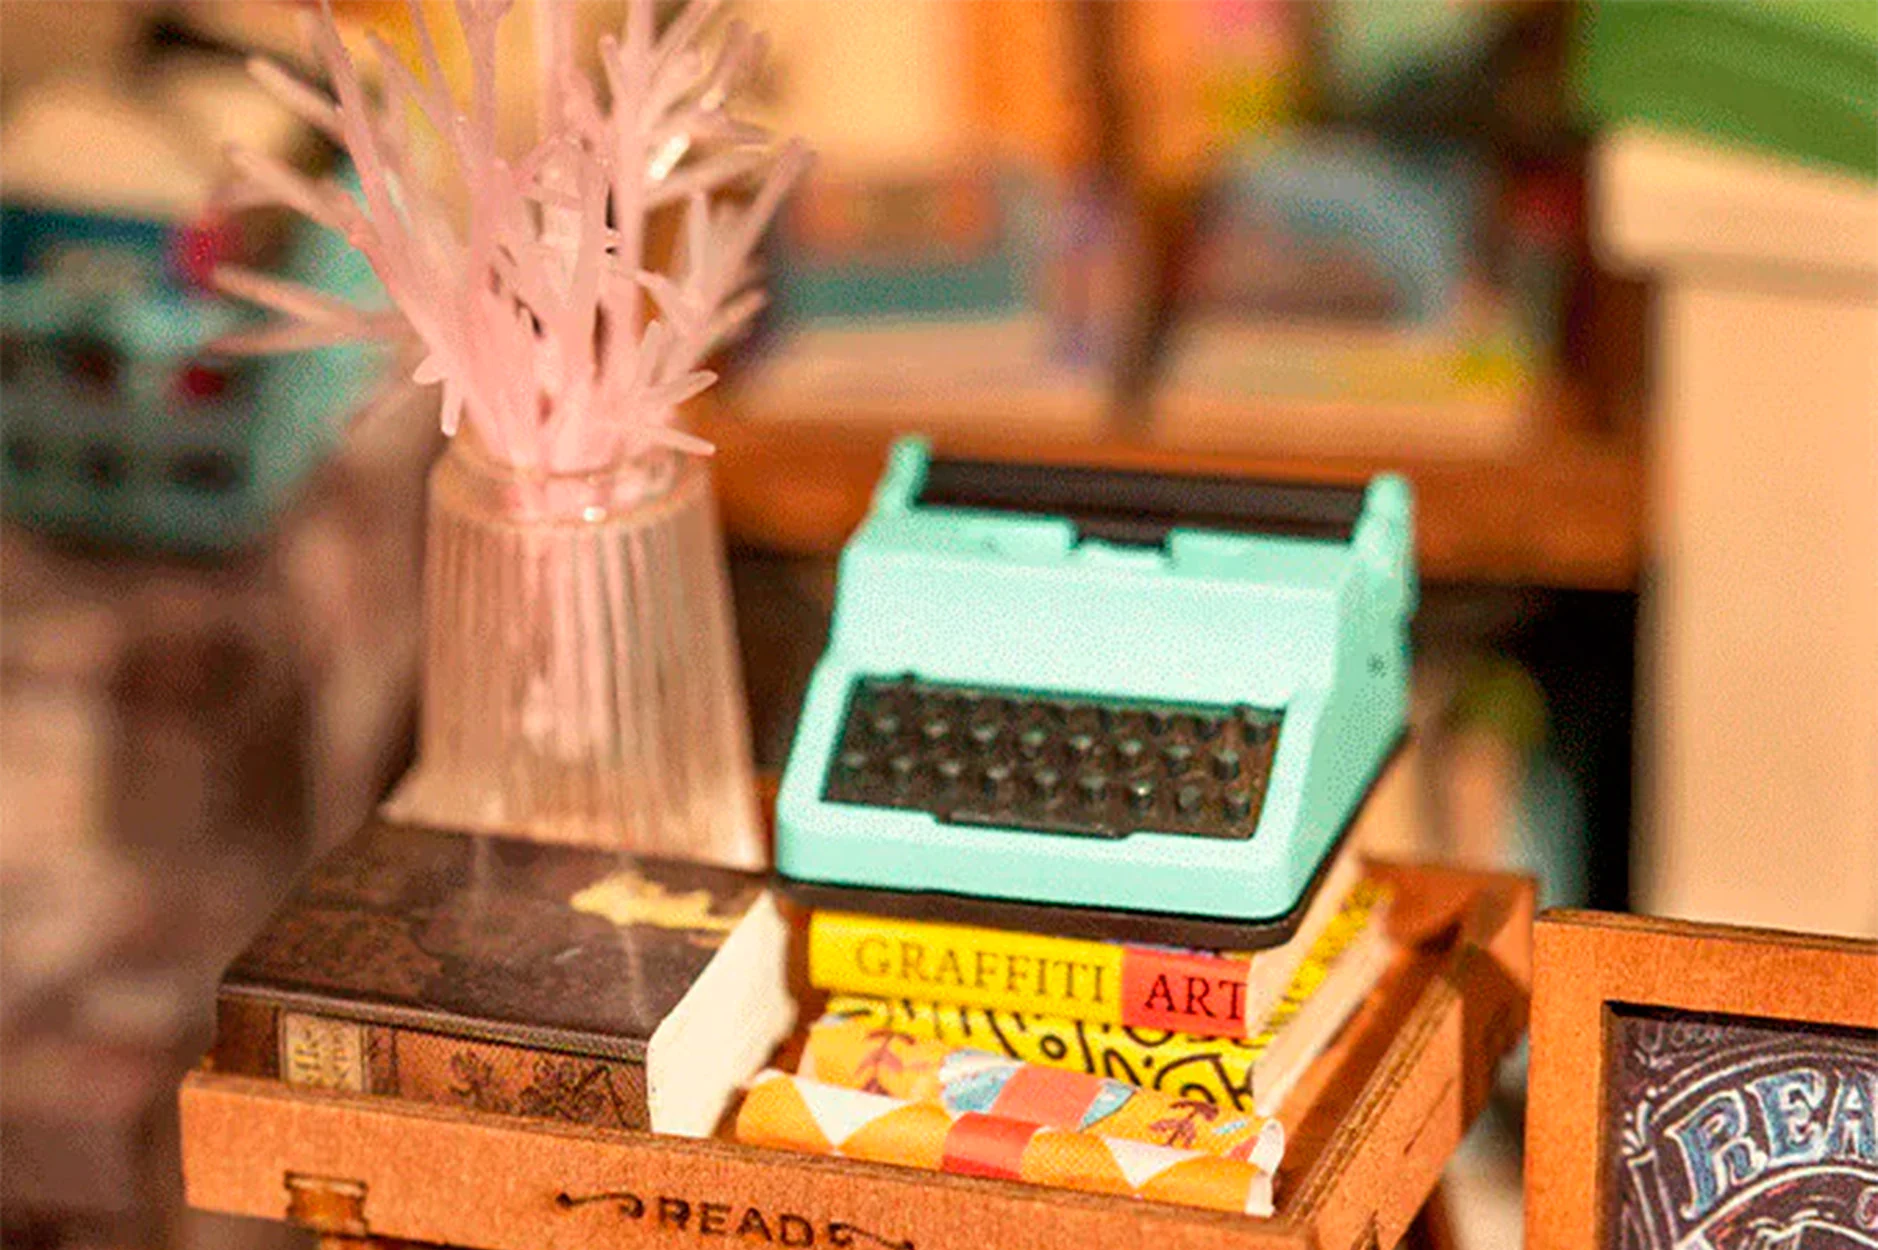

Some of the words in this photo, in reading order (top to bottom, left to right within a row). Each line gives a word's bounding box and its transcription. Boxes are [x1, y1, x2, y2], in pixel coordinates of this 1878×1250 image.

[855, 937, 1105, 1004] GRAFFITI
[1144, 974, 1247, 1022] ART
[658, 1195, 815, 1249] READ
